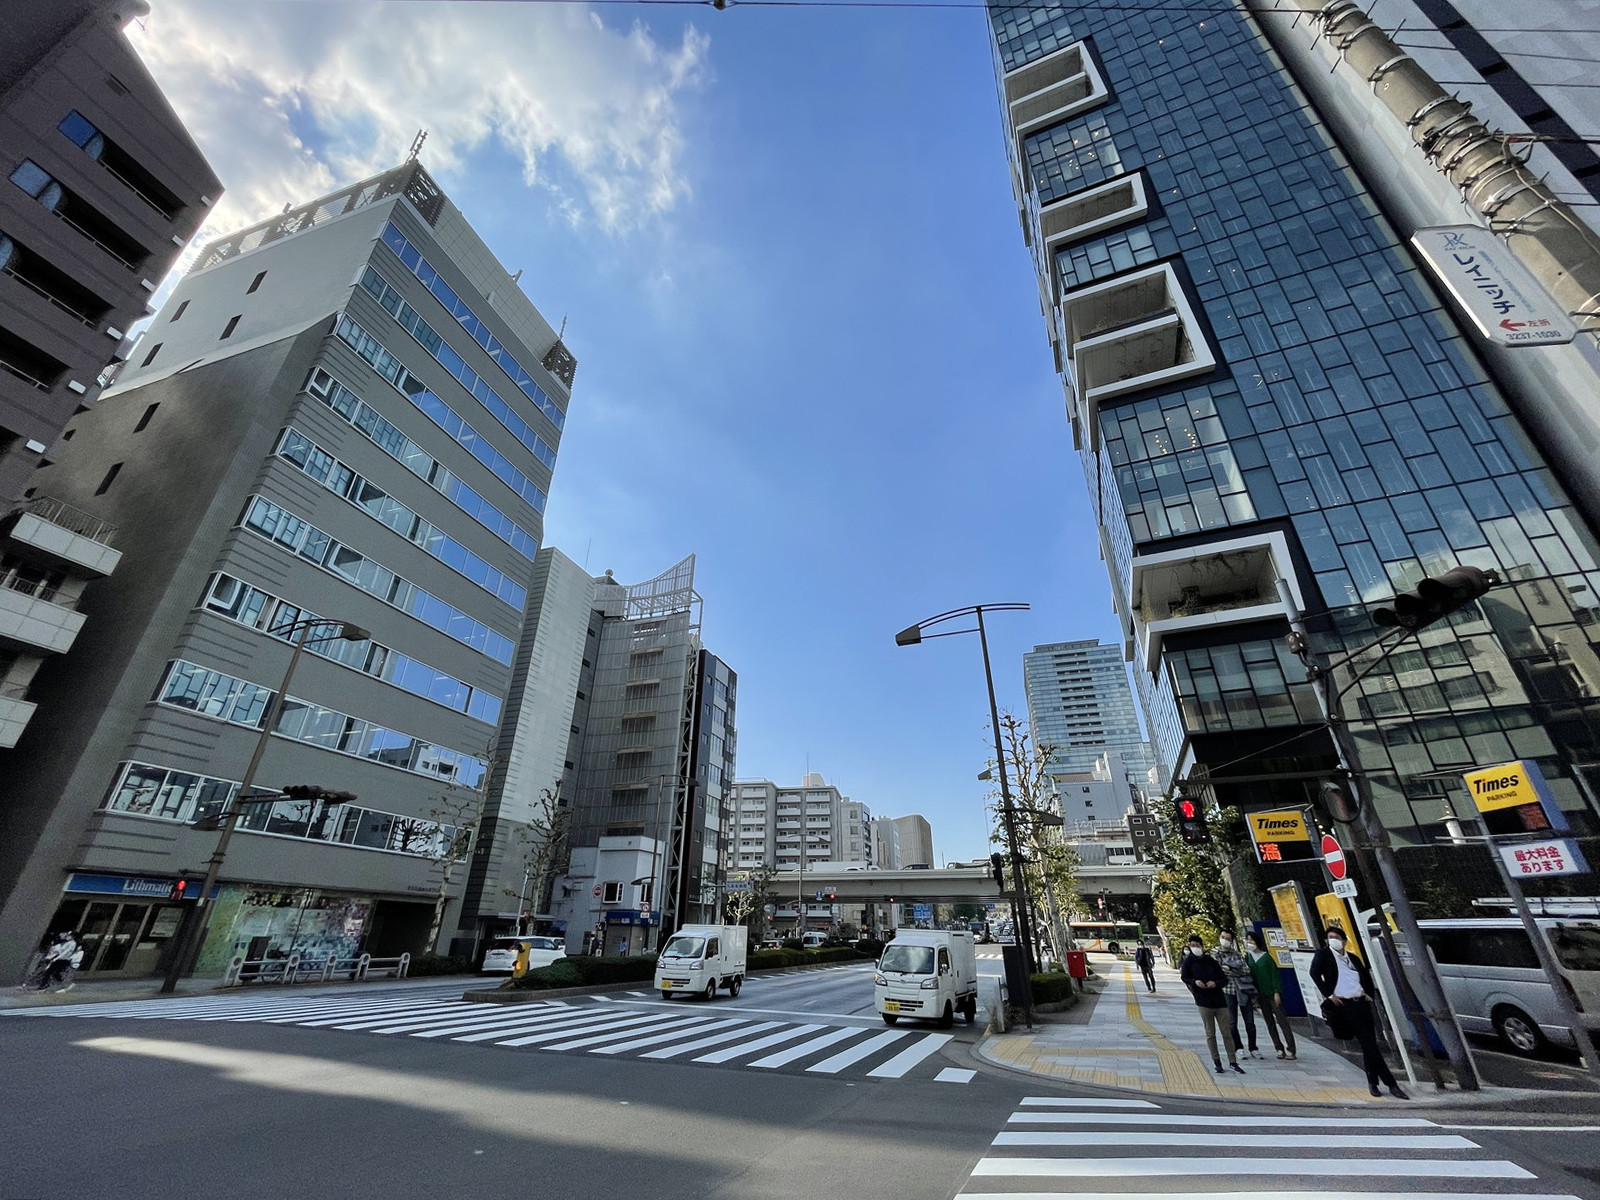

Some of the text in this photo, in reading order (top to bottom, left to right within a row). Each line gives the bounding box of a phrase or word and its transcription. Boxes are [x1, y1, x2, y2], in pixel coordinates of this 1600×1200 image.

[1473, 774, 1519, 794] Times
[1486, 791, 1518, 802] PARKING
[1257, 818, 1299, 829] Times
[1259, 843, 1282, 861] 満
[1514, 846, 1562, 862] 最大料金
[1519, 859, 1564, 874] あります
